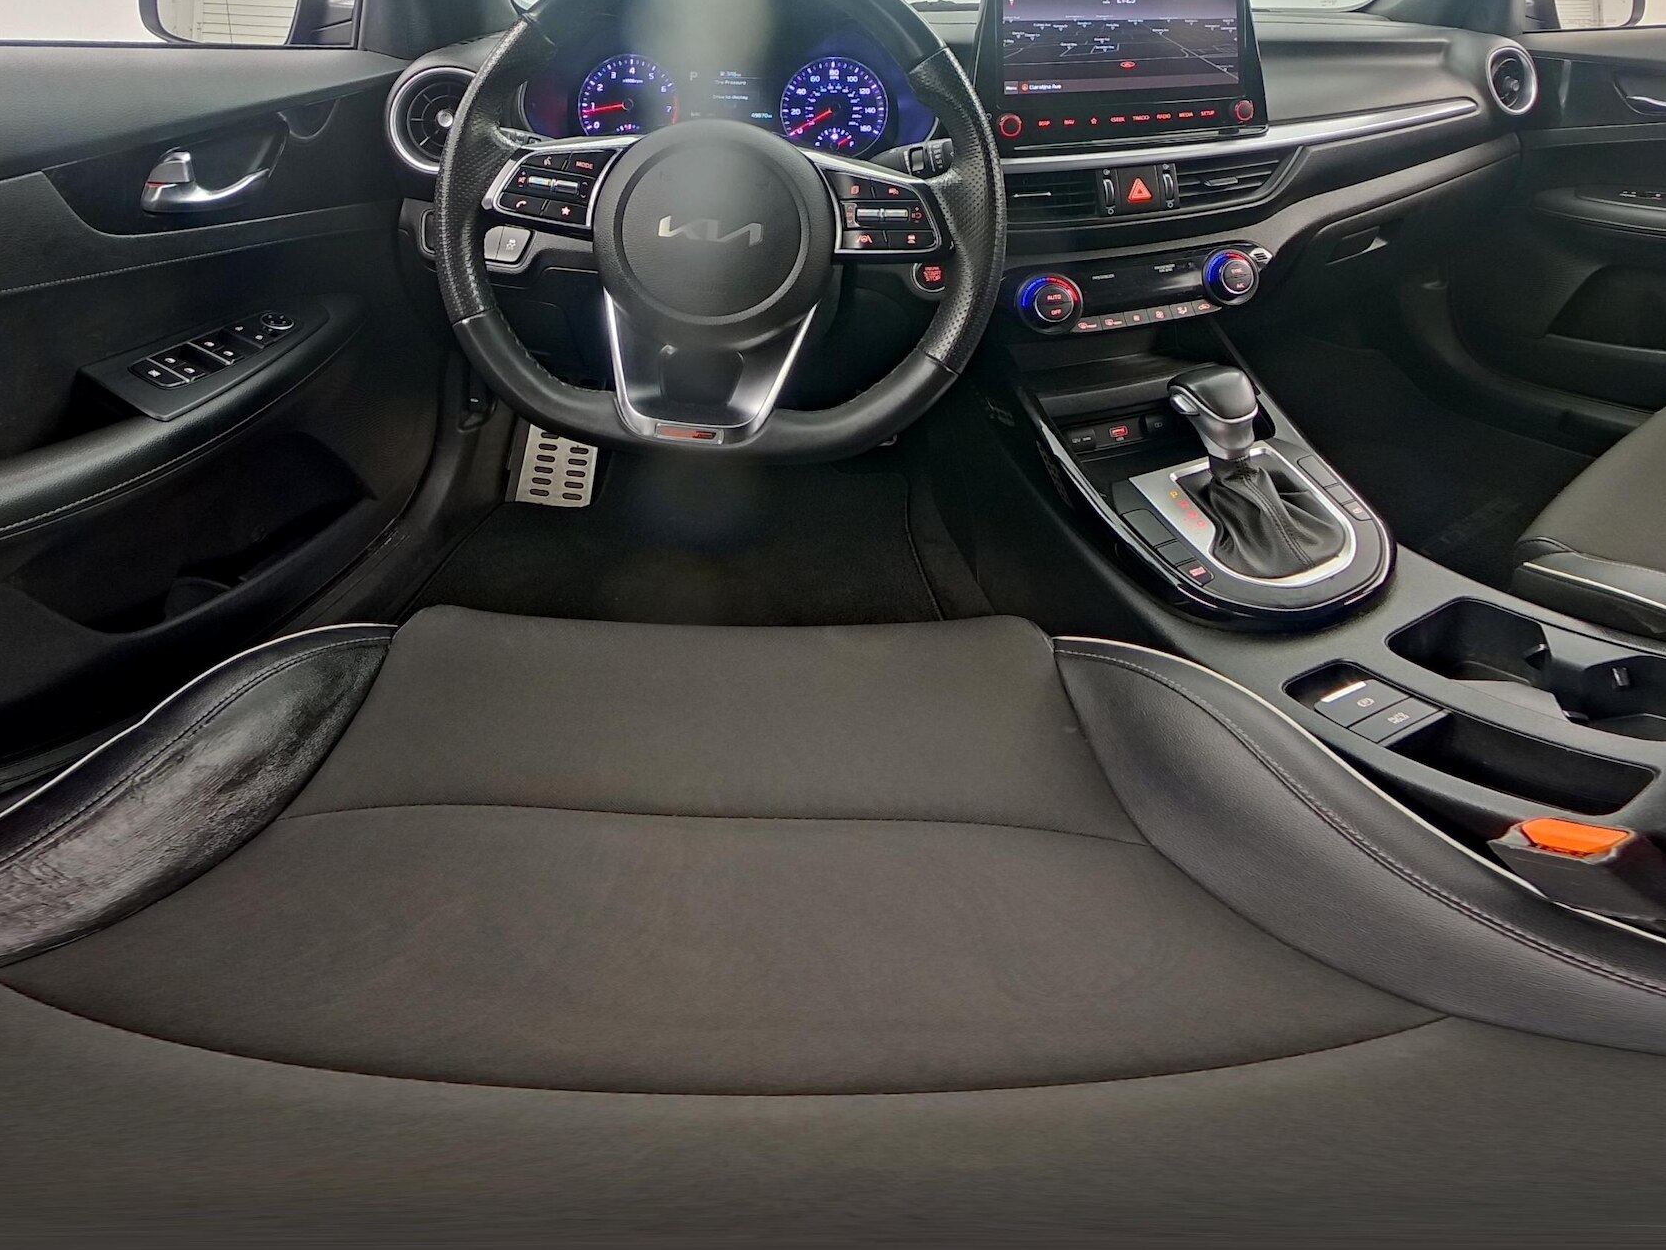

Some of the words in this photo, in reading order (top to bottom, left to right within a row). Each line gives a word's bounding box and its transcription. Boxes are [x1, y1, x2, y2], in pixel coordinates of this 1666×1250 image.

[629, 66, 636, 75] 4
[610, 71, 617, 79] 3
[648, 72, 655, 80] 5
[689, 71, 698, 81] P
[596, 84, 603, 92] 2
[660, 85, 667, 93] 6
[593, 121, 600, 129] 0
[575, 160, 594, 170] MODE
